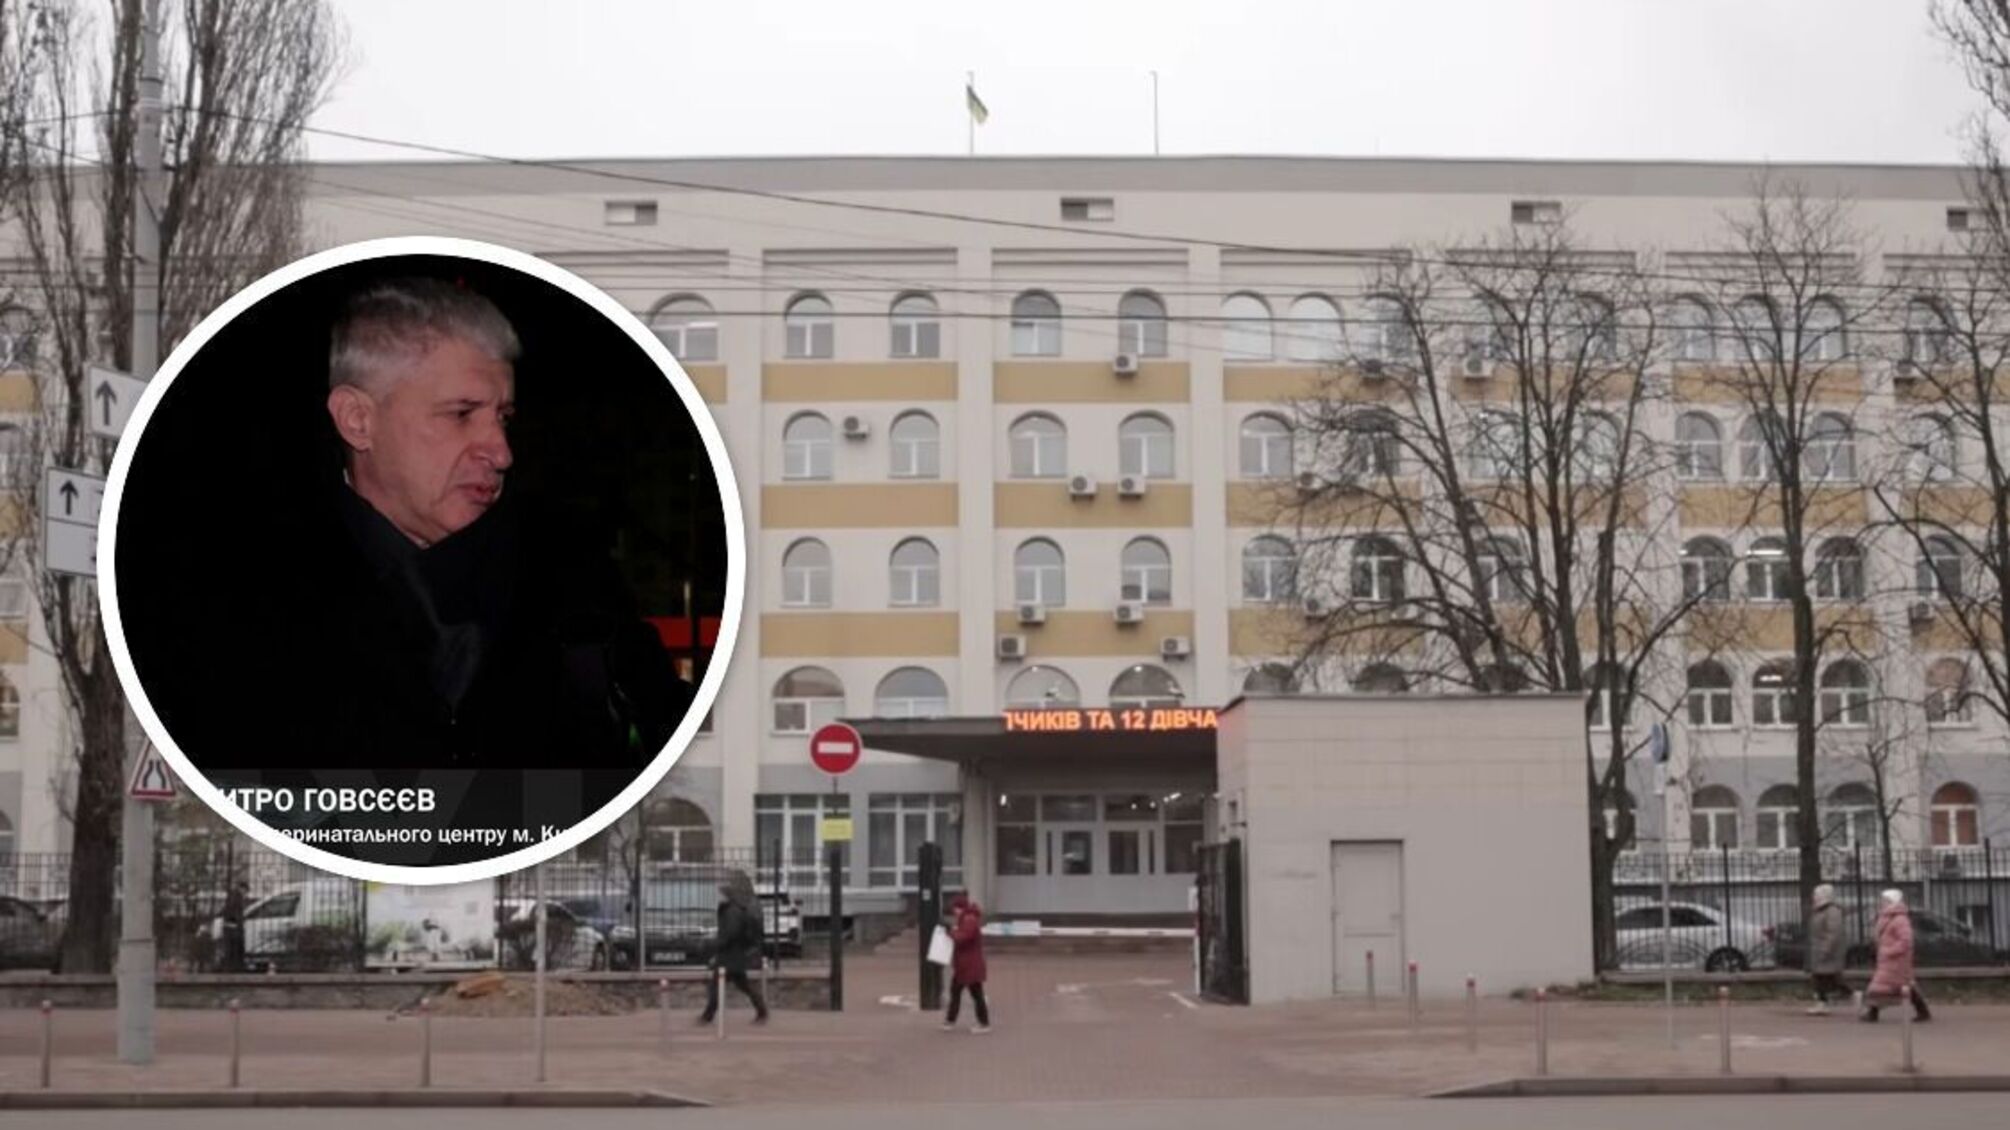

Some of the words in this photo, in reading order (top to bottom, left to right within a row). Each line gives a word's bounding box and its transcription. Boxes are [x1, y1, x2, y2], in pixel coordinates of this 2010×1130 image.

[1087, 711, 1115, 731] ТА
[1120, 711, 1145, 730] 12
[1150, 709, 1218, 731] ДІВЧА
